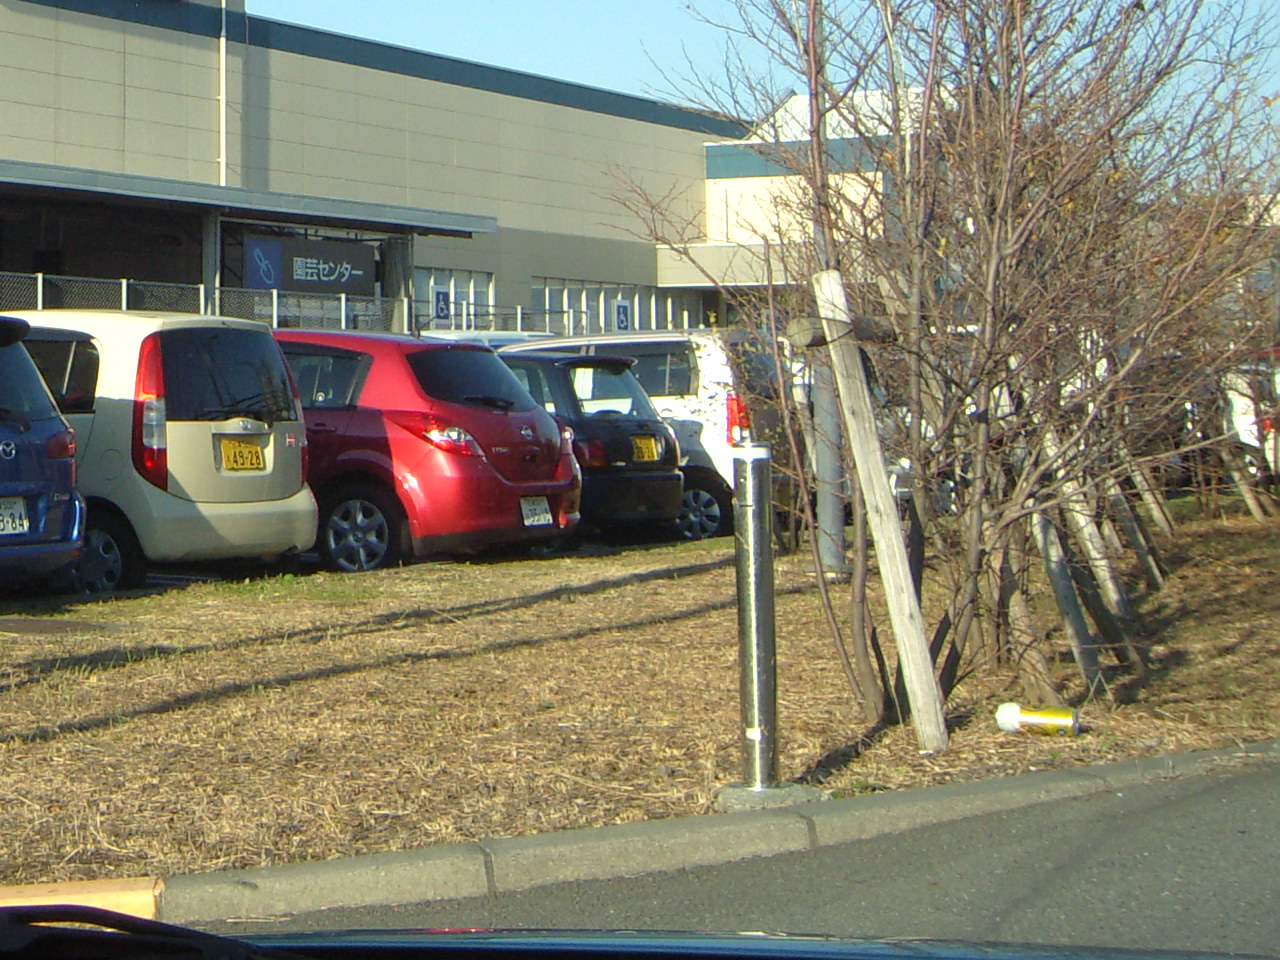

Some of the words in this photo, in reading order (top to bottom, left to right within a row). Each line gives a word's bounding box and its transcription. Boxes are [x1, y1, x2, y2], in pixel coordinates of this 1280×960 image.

[293, 257, 363, 283] 園芸センター
